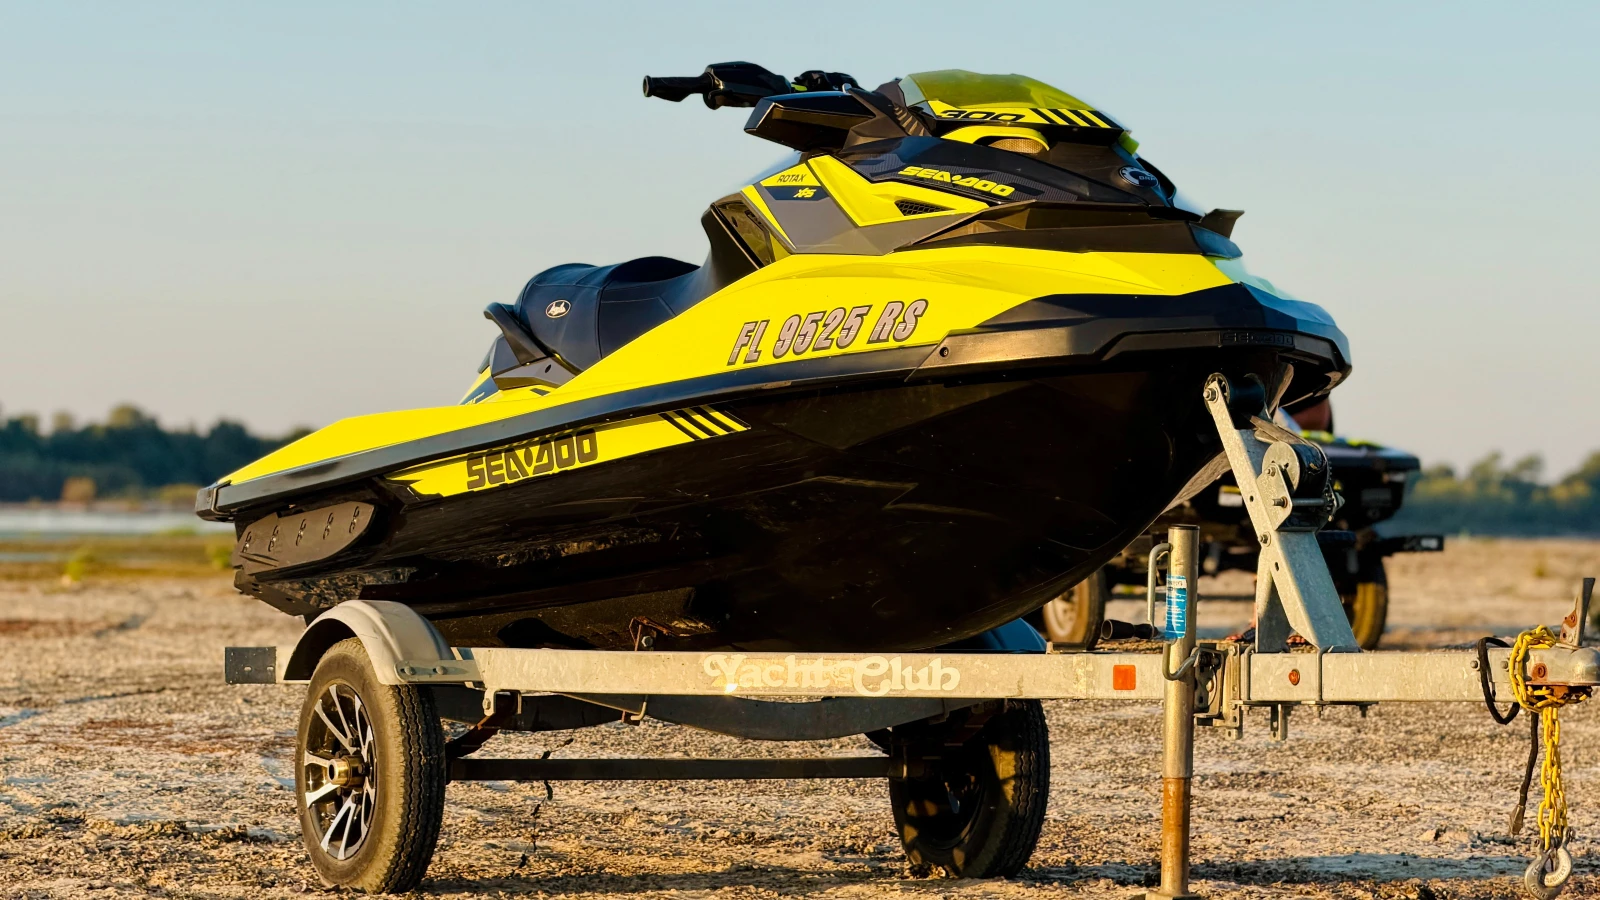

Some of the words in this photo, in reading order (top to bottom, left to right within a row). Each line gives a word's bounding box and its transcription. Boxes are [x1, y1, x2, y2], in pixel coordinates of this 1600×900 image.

[936, 109, 1026, 122] 300
[776, 174, 807, 183] ROTAX
[726, 319, 770, 366] FL
[772, 304, 873, 359] 9525
[866, 298, 929, 345] RS
[853, 655, 961, 697] Club
